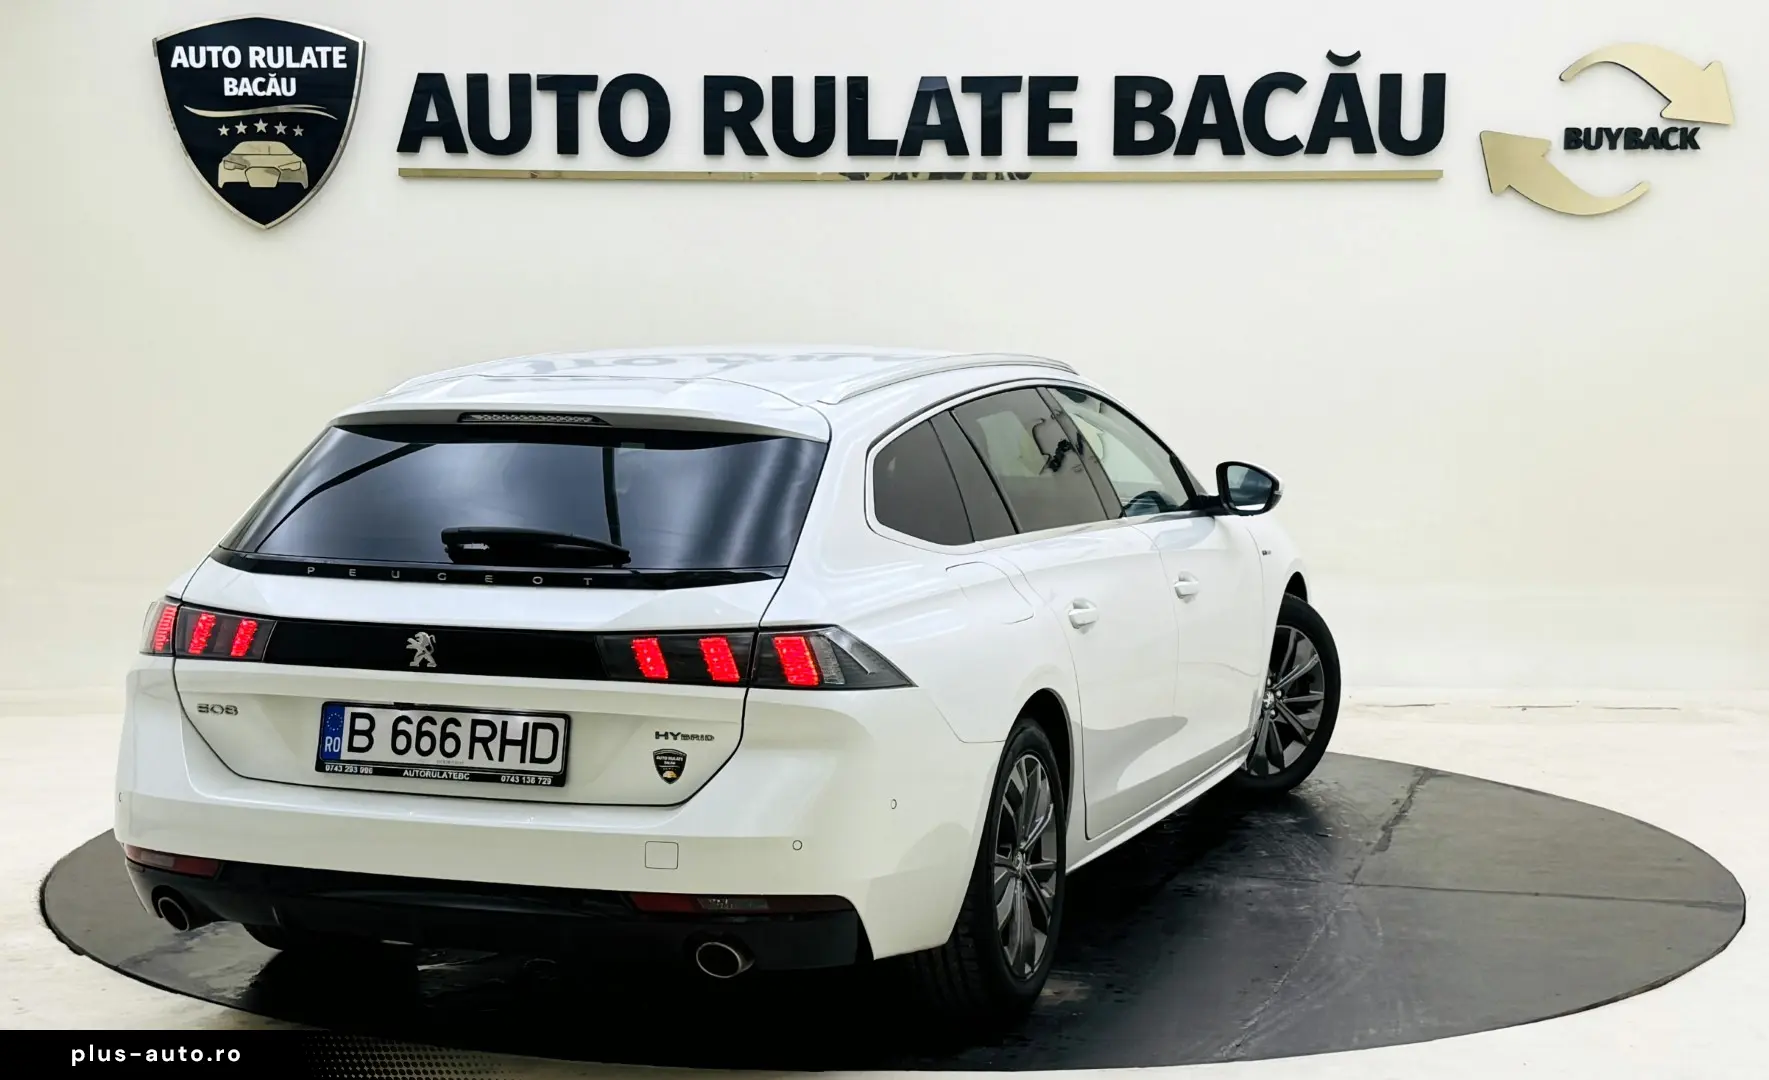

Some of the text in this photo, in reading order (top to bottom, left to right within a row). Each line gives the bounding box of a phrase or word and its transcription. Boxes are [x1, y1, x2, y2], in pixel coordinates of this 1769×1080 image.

[170, 46, 348, 69] AUTO RULATE
[223, 72, 297, 97] BACĂU
[397, 50, 1447, 158] AUTO RULATE BACĂU
[1563, 126, 1701, 150] BUYBACK
[307, 566, 593, 586] PEUGEOT
[197, 703, 239, 716] 508
[324, 736, 341, 753] RO
[347, 712, 559, 764] B 666 RHD
[655, 731, 715, 741] HYBRID
[403, 769, 470, 780] AUTORULATEBC
[501, 775, 520, 783] 0743
